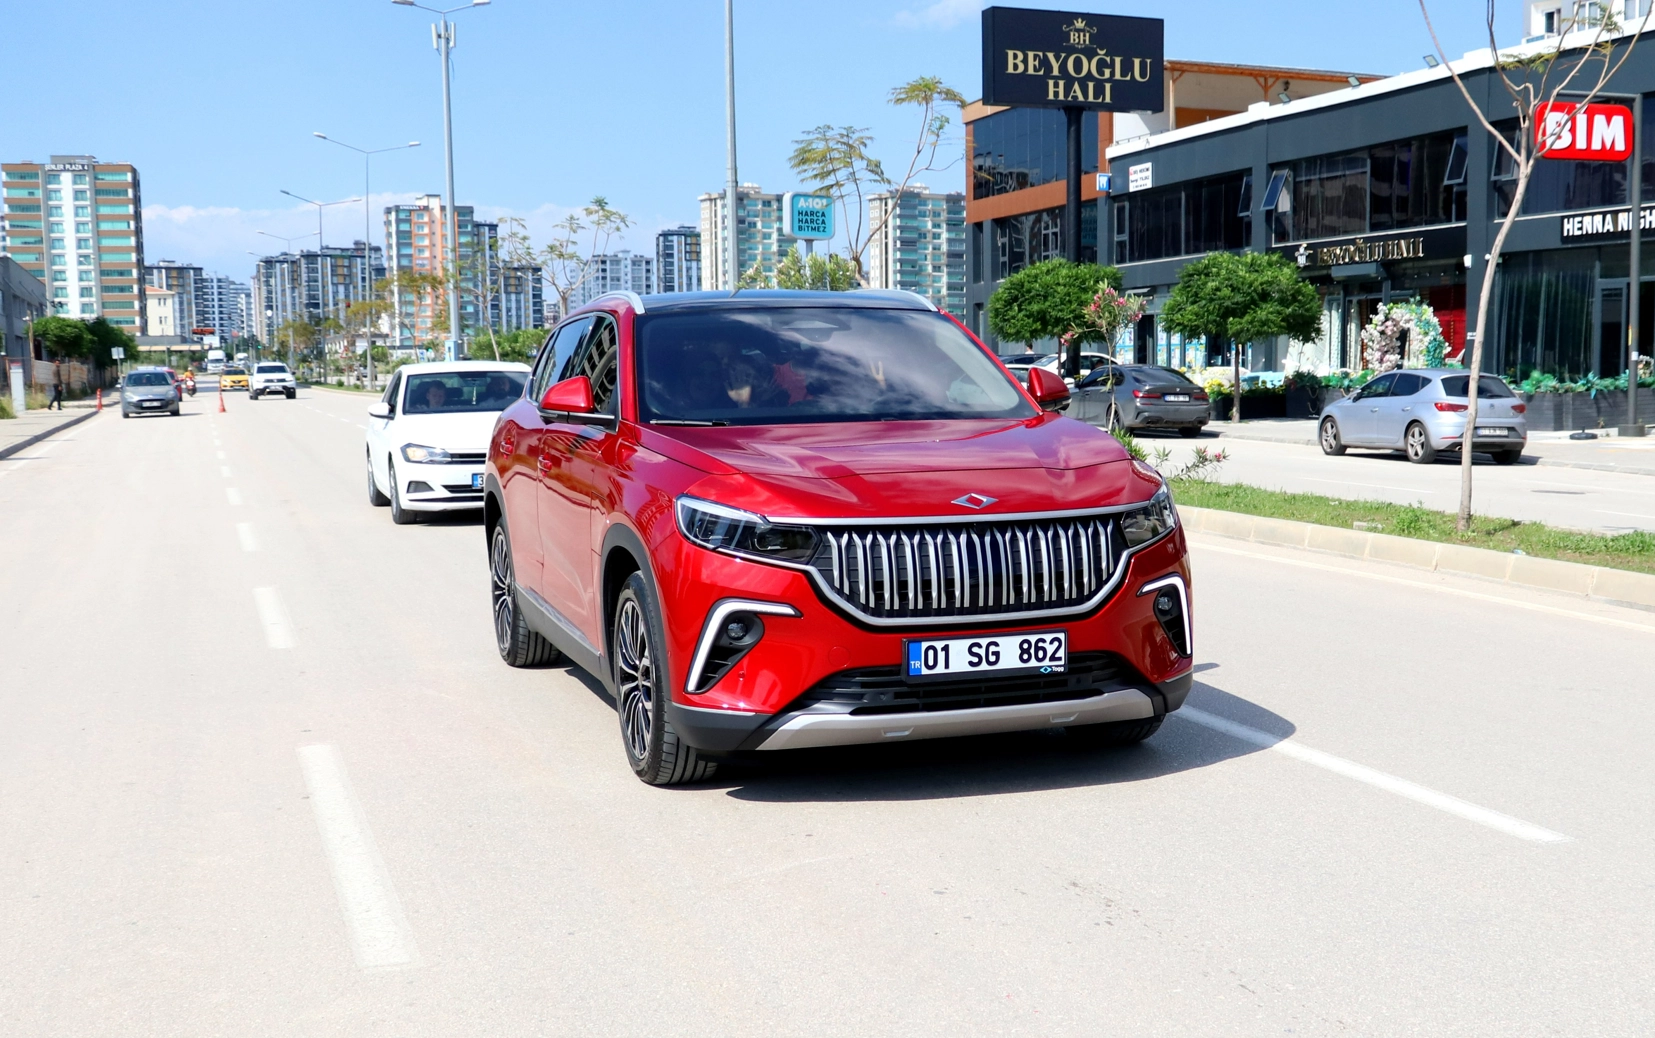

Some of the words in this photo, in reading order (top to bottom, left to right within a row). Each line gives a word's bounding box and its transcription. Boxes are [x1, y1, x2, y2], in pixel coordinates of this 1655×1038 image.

[1069, 31, 1090, 45] BH
[1005, 48, 1152, 83] BEYOĞLU
[1047, 79, 1113, 104] HALI
[1545, 104, 1626, 152] BİM
[797, 210, 826, 218] HARCA
[797, 217, 827, 225] HARCA
[1563, 213, 1614, 237] HENNA
[910, 660, 921, 670] TR
[923, 643, 950, 671] 01
[967, 641, 1001, 667] SG
[1018, 636, 1063, 664] 862
